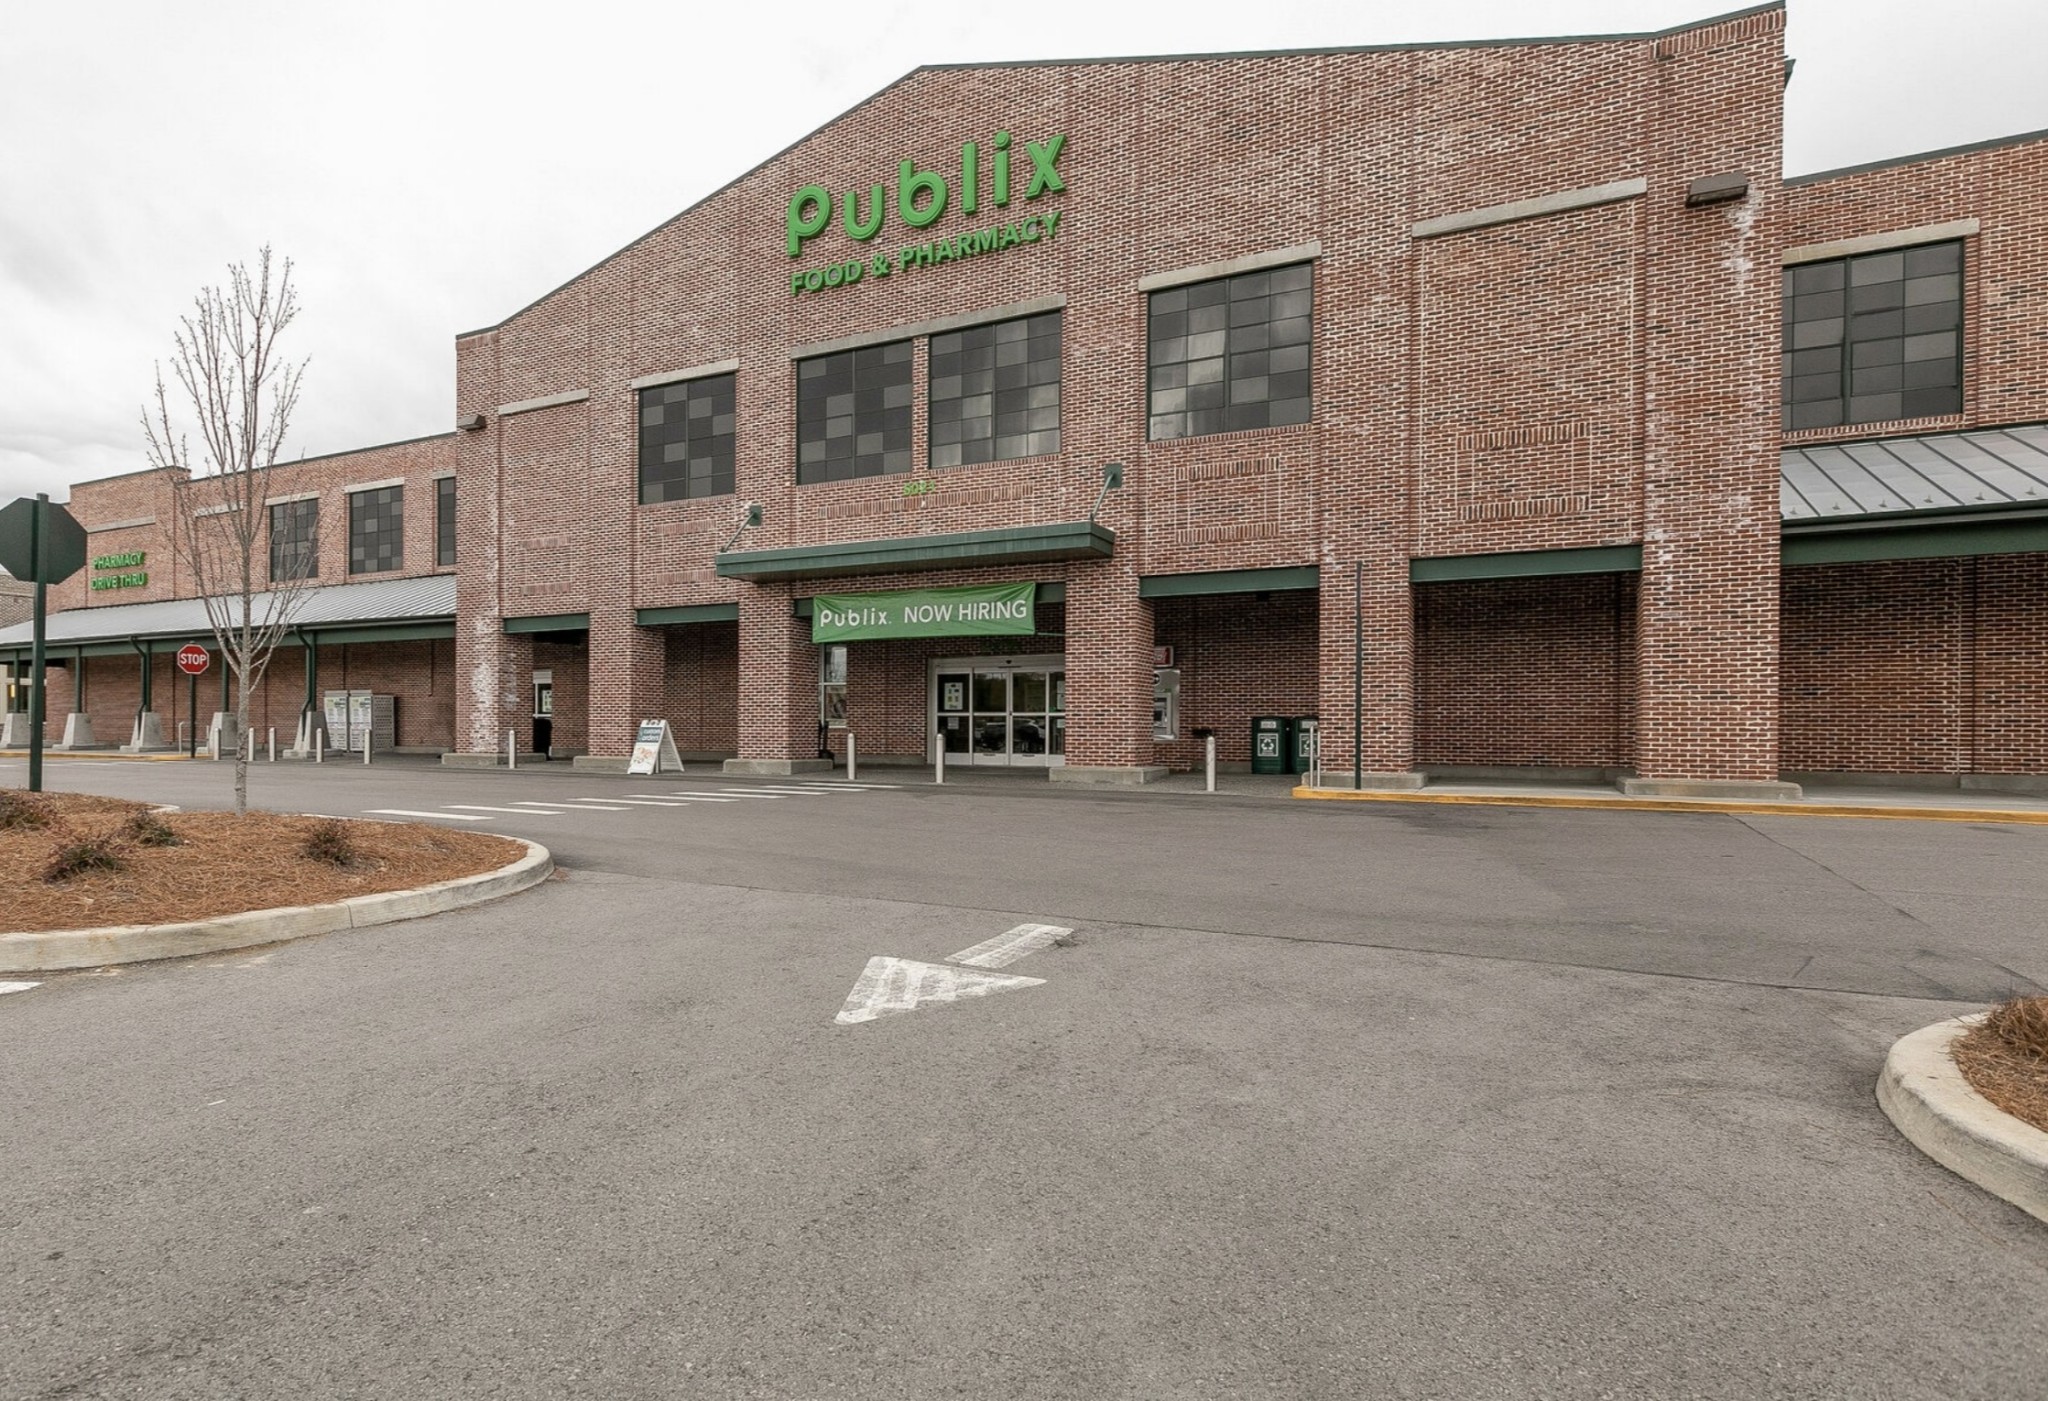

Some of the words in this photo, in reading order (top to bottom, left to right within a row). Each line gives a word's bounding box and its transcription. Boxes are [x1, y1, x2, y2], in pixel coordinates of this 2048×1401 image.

[787, 129, 1067, 257] Publix
[791, 260, 864, 295] FOOD
[871, 253, 891, 279] &
[900, 211, 1063, 272] PHARMACY
[93, 551, 145, 570] PHARMACY
[91, 575, 118, 590] DRIVE
[119, 572, 148, 588] THRU
[904, 604, 953, 624] NOW
[958, 600, 1027, 621] HIRING
[180, 653, 207, 665] STOP
